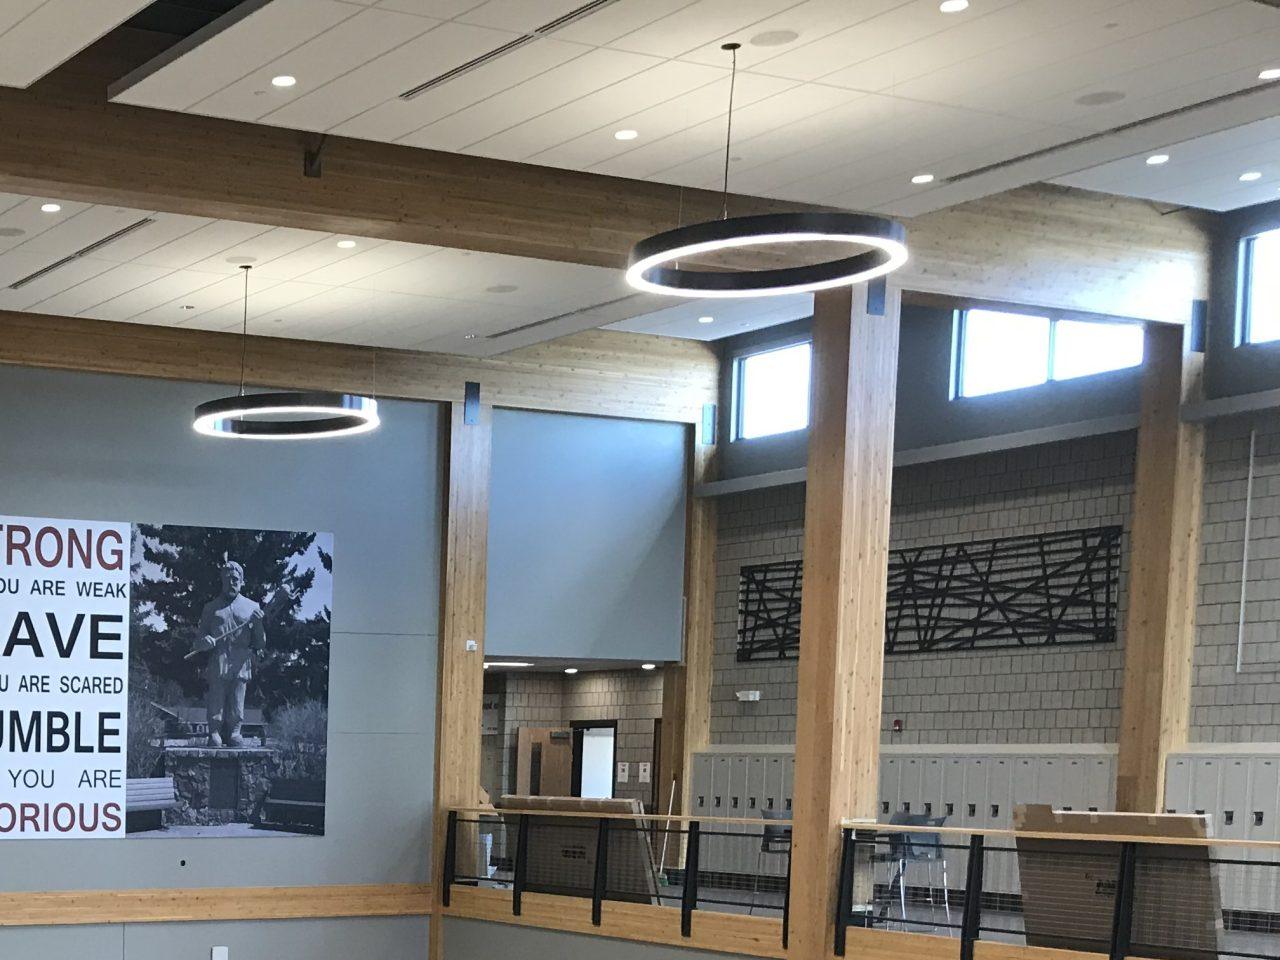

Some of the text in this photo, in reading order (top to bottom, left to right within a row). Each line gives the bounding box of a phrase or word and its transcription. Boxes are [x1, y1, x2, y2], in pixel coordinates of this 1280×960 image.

[29, 579, 66, 596] ARE
[75, 581, 127, 599] WEAK
[18, 675, 50, 693] ARE
[59, 675, 124, 694] SCARED
[7, 769, 55, 789] YOU
[78, 769, 122, 789] ARE
